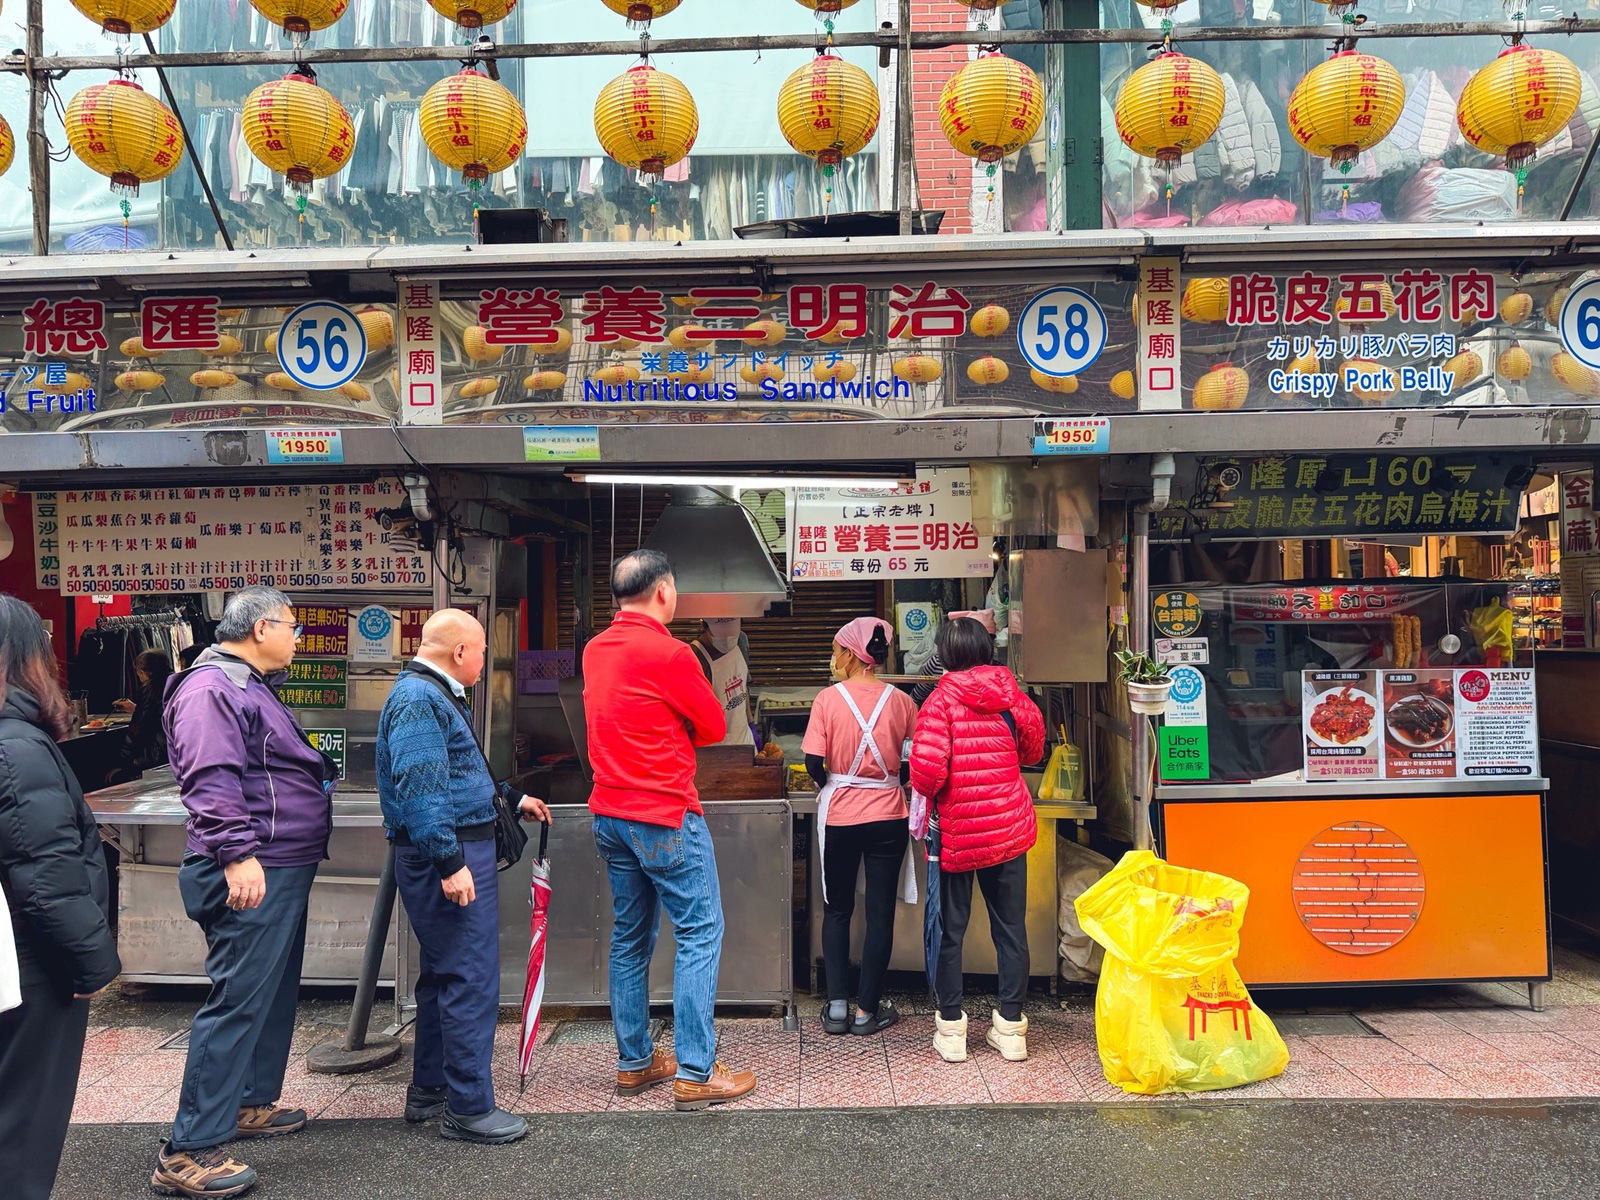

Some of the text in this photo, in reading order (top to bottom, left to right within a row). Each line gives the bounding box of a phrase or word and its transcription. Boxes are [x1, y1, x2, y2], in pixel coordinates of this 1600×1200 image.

[1227, 269, 1496, 326] 脆皮五花肉
[478, 281, 971, 344] 營養三明治
[22, 296, 221, 355] 總匯
[1146, 266, 1174, 391] 基隆廟口
[1036, 304, 1088, 361] 58
[296, 318, 348, 374] 56
[406, 284, 434, 406] 基隆廟口
[1268, 334, 1455, 360] カリカリ豚バラ肉
[641, 350, 844, 373] 栄養サンドイッチ
[1270, 367, 1454, 396] Crispy Pork Belly
[584, 376, 910, 402] Nutritious Sandwich
[28, 389, 97, 413] Fruit
[1052, 430, 1092, 442] 1950
[285, 440, 325, 452] 1950
[94, 491, 109, 577] 鳳梨牛乳
[244, 487, 257, 572] 柳丁汁
[800, 526, 827, 540] 基隆
[66, 492, 81, 592] 西瓜牛乳 50
[80, 491, 96, 592] 木瓜牛乳 50
[110, 491, 126, 592] 香蕉牛乳 50
[199, 488, 213, 589] 西瓜汁 45
[834, 522, 979, 553] 營養三明治
[800, 540, 827, 554] 廟口
[850, 558, 882, 574] 每份
[889, 557, 907, 570] 65
[914, 558, 929, 572] 元
[42, 574, 58, 586] 45
[215, 577, 229, 589] 50
[230, 576, 244, 588] 50
[260, 575, 275, 587] 50
[276, 575, 287, 585] 50
[290, 574, 304, 586] 50
[306, 574, 320, 586] 50
[352, 572, 366, 584] 50
[381, 572, 395, 583] 50
[397, 572, 410, 583] 70
[411, 572, 425, 583] 70
[97, 580, 112, 592] 50
[126, 579, 140, 592] 50
[142, 579, 154, 591] 50
[155, 579, 169, 591] 50
[171, 579, 185, 590] 50
[1158, 609, 1196, 622] 台灣豬
[1490, 672, 1530, 680] MENU
[1168, 735, 1199, 746] Uber
[1169, 748, 1200, 759] Eats
[1167, 762, 1204, 771] 合作商家
